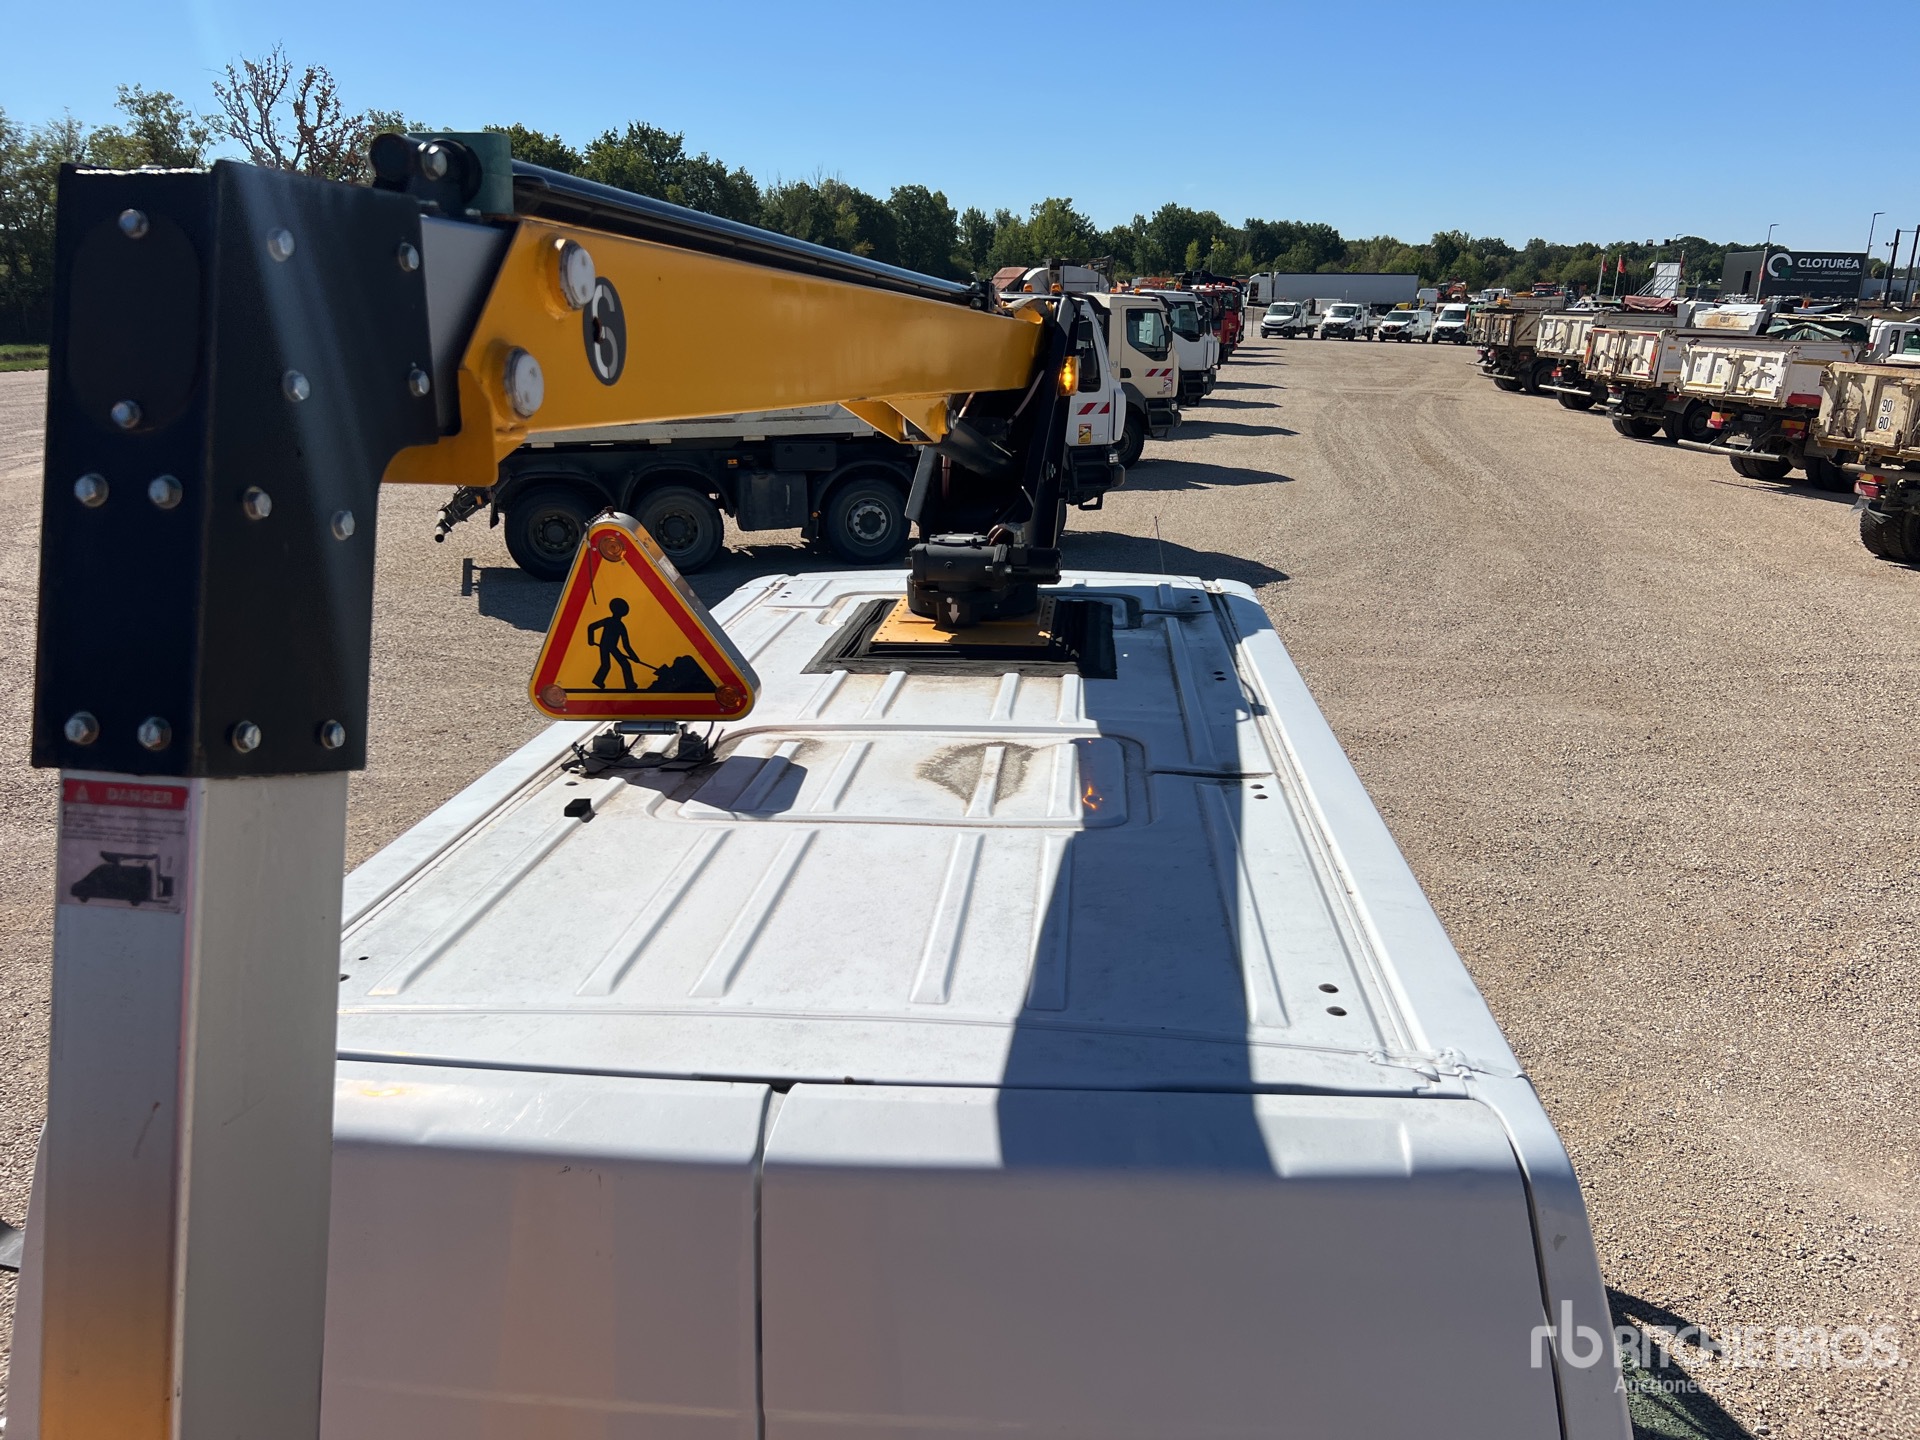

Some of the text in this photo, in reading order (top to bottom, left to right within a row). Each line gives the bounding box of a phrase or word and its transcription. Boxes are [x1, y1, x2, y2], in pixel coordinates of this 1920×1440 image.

[1797, 257, 1860, 268] CLOTURÉA
[1881, 399, 1893, 412] 90
[1878, 416, 1889, 430] 80
[106, 787, 173, 804] DANGER
